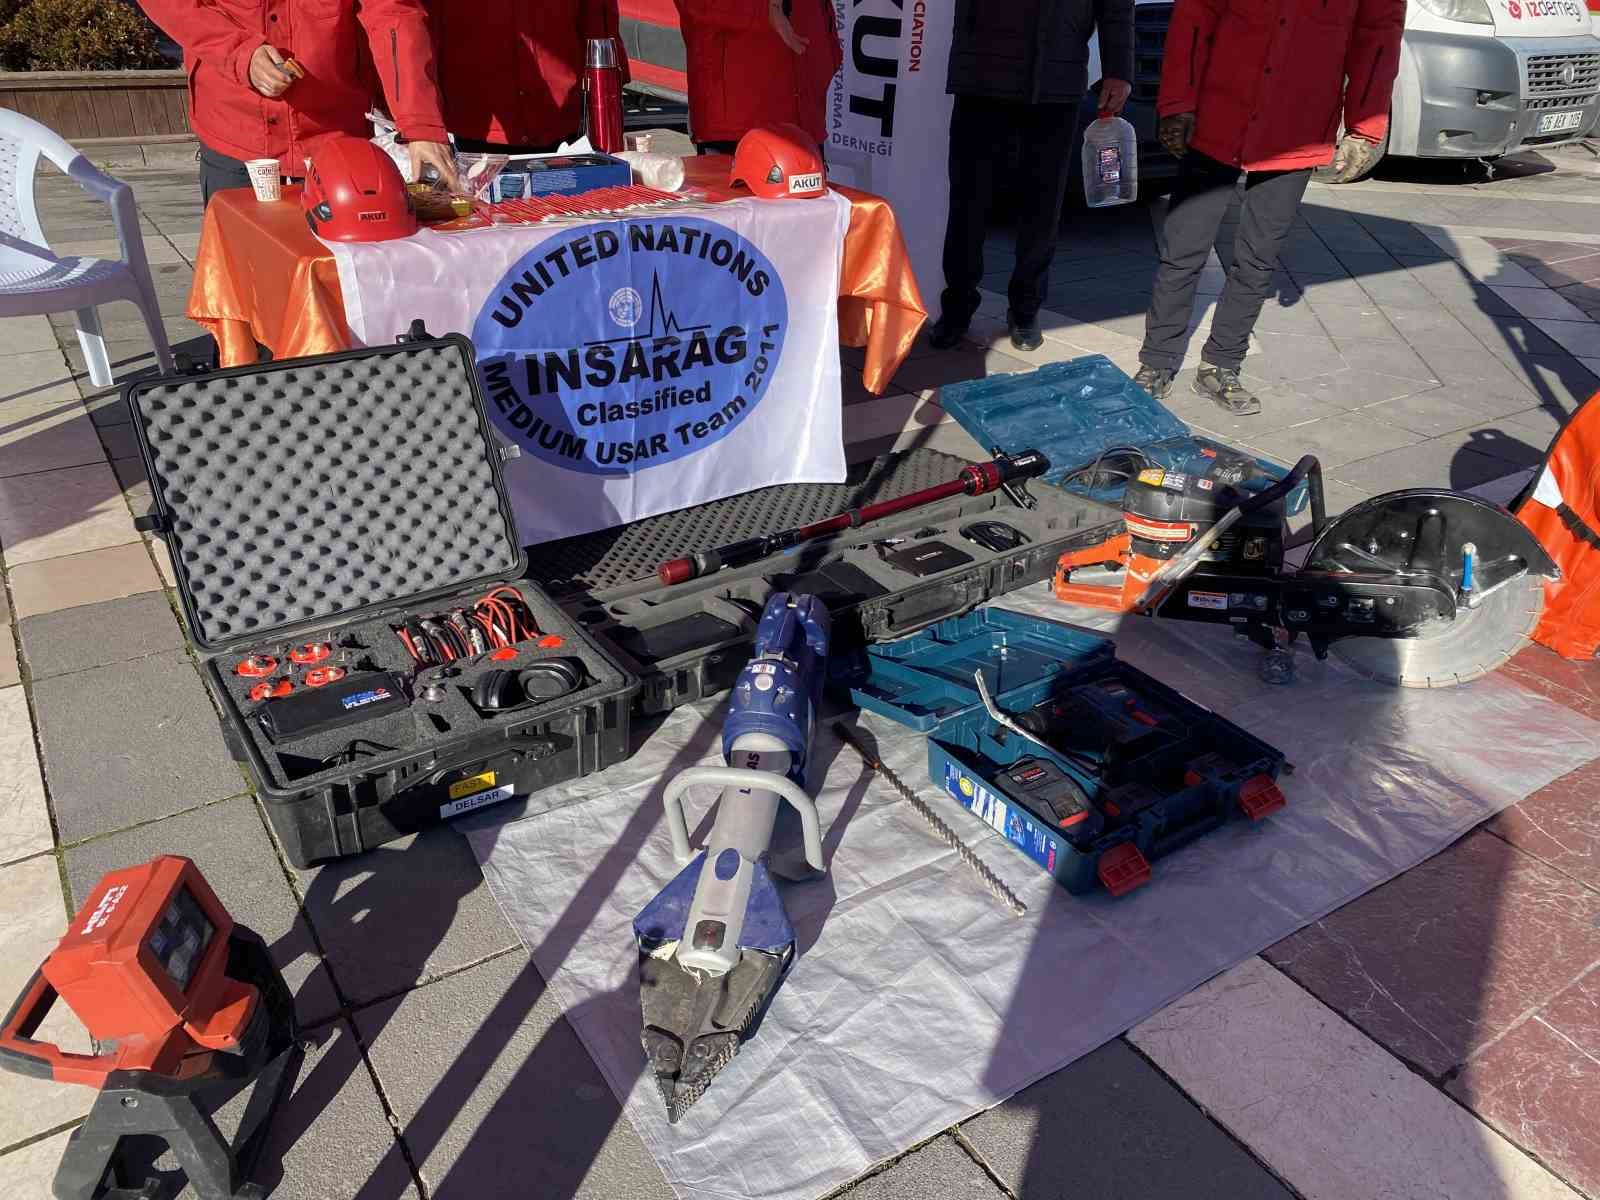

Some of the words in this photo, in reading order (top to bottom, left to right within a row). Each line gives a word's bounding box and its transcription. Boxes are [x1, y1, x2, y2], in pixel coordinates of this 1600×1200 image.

[850, 0, 903, 138] UT
[832, 132, 893, 156] DERNEĞİ
[793, 176, 820, 189] AKUT
[491, 229, 619, 328] UNITED
[630, 224, 770, 297] NATIONS
[525, 325, 747, 395] INSARAG
[484, 361, 588, 460] MEDIUM
[595, 433, 669, 464] USAR
[674, 395, 747, 445] Team
[744, 323, 780, 394] 2011
[577, 381, 711, 426] Classified
[739, 752, 760, 795] LAS
[455, 791, 499, 811] DELSAR
